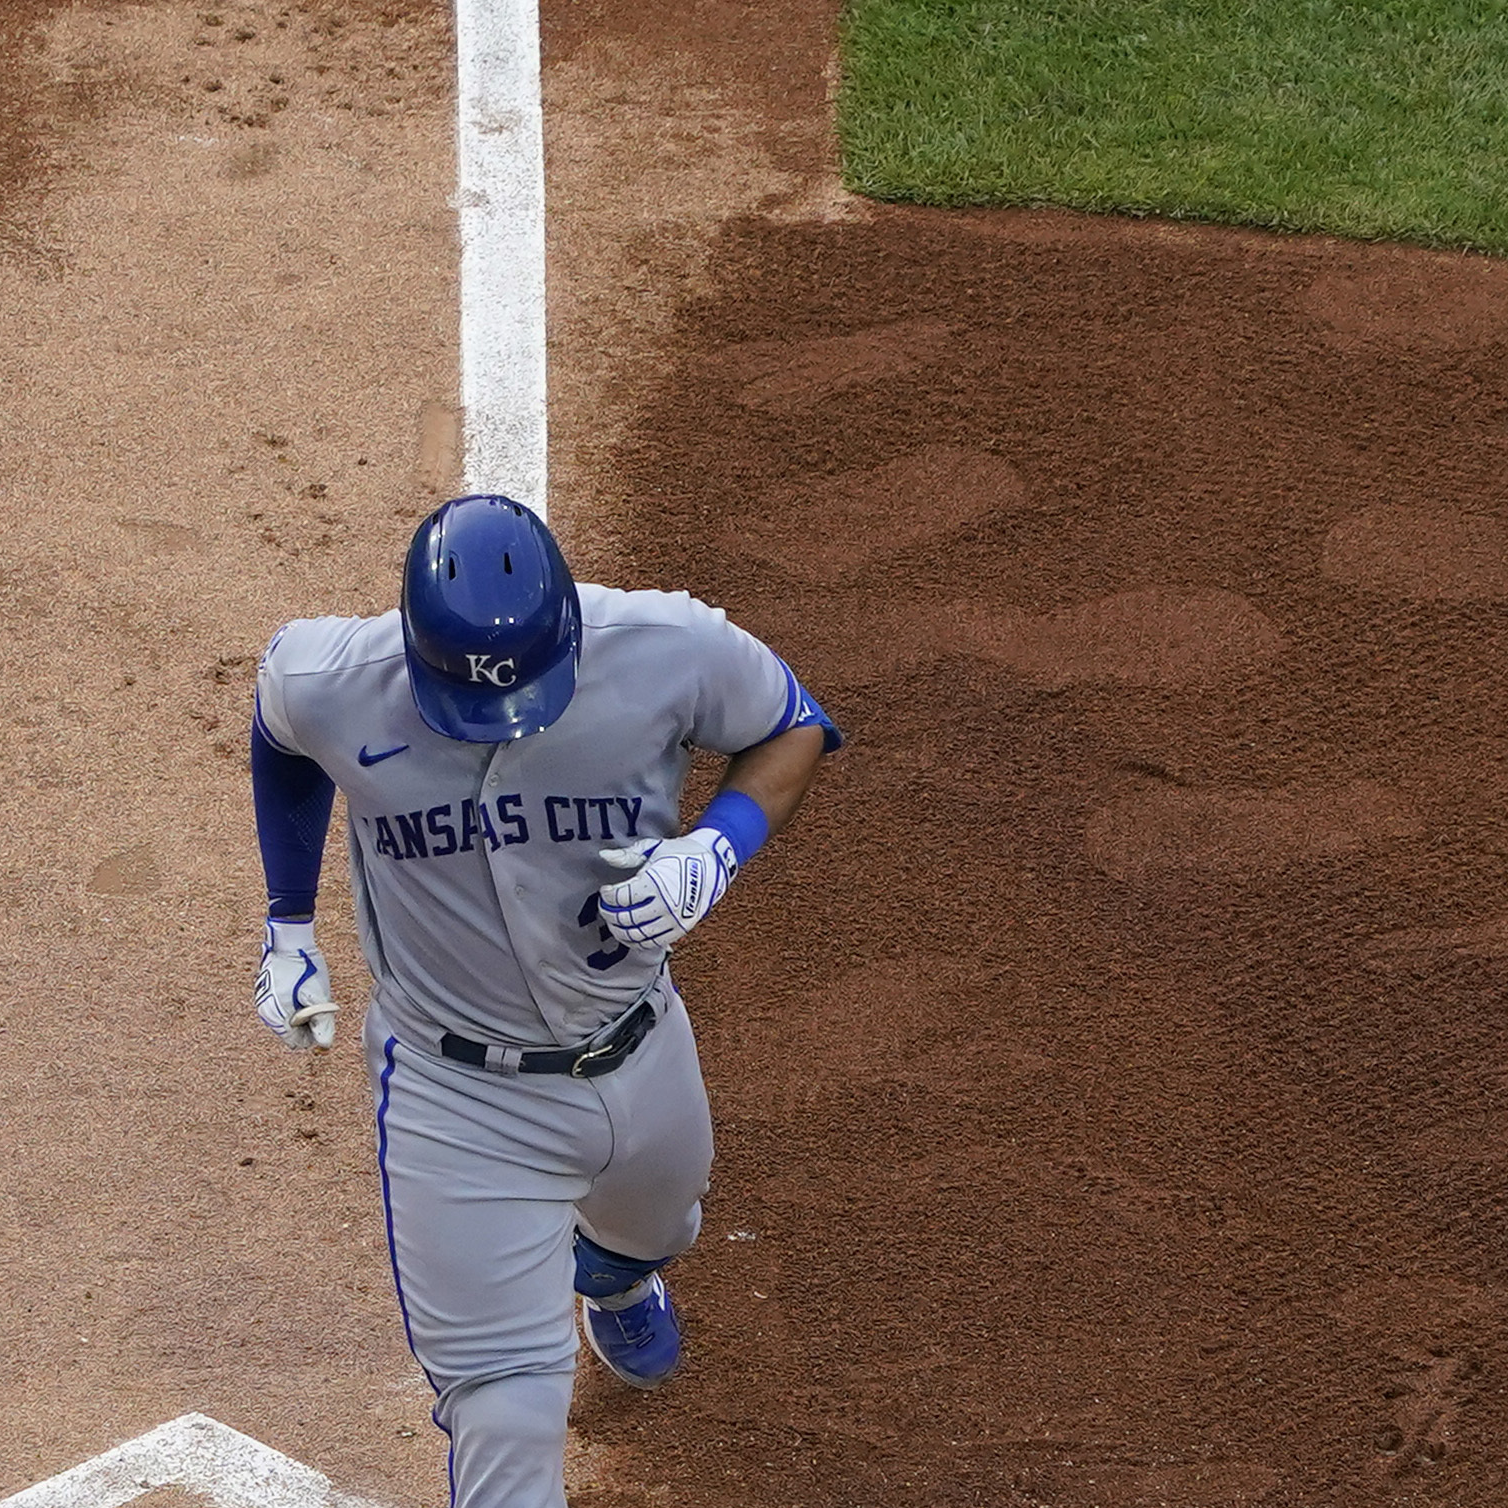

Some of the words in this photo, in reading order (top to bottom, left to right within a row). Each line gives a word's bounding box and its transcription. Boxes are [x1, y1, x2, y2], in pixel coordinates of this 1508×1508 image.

[465, 654, 517, 687] KC
[362, 794, 529, 860] ANSAS
[544, 796, 642, 842] CITY
